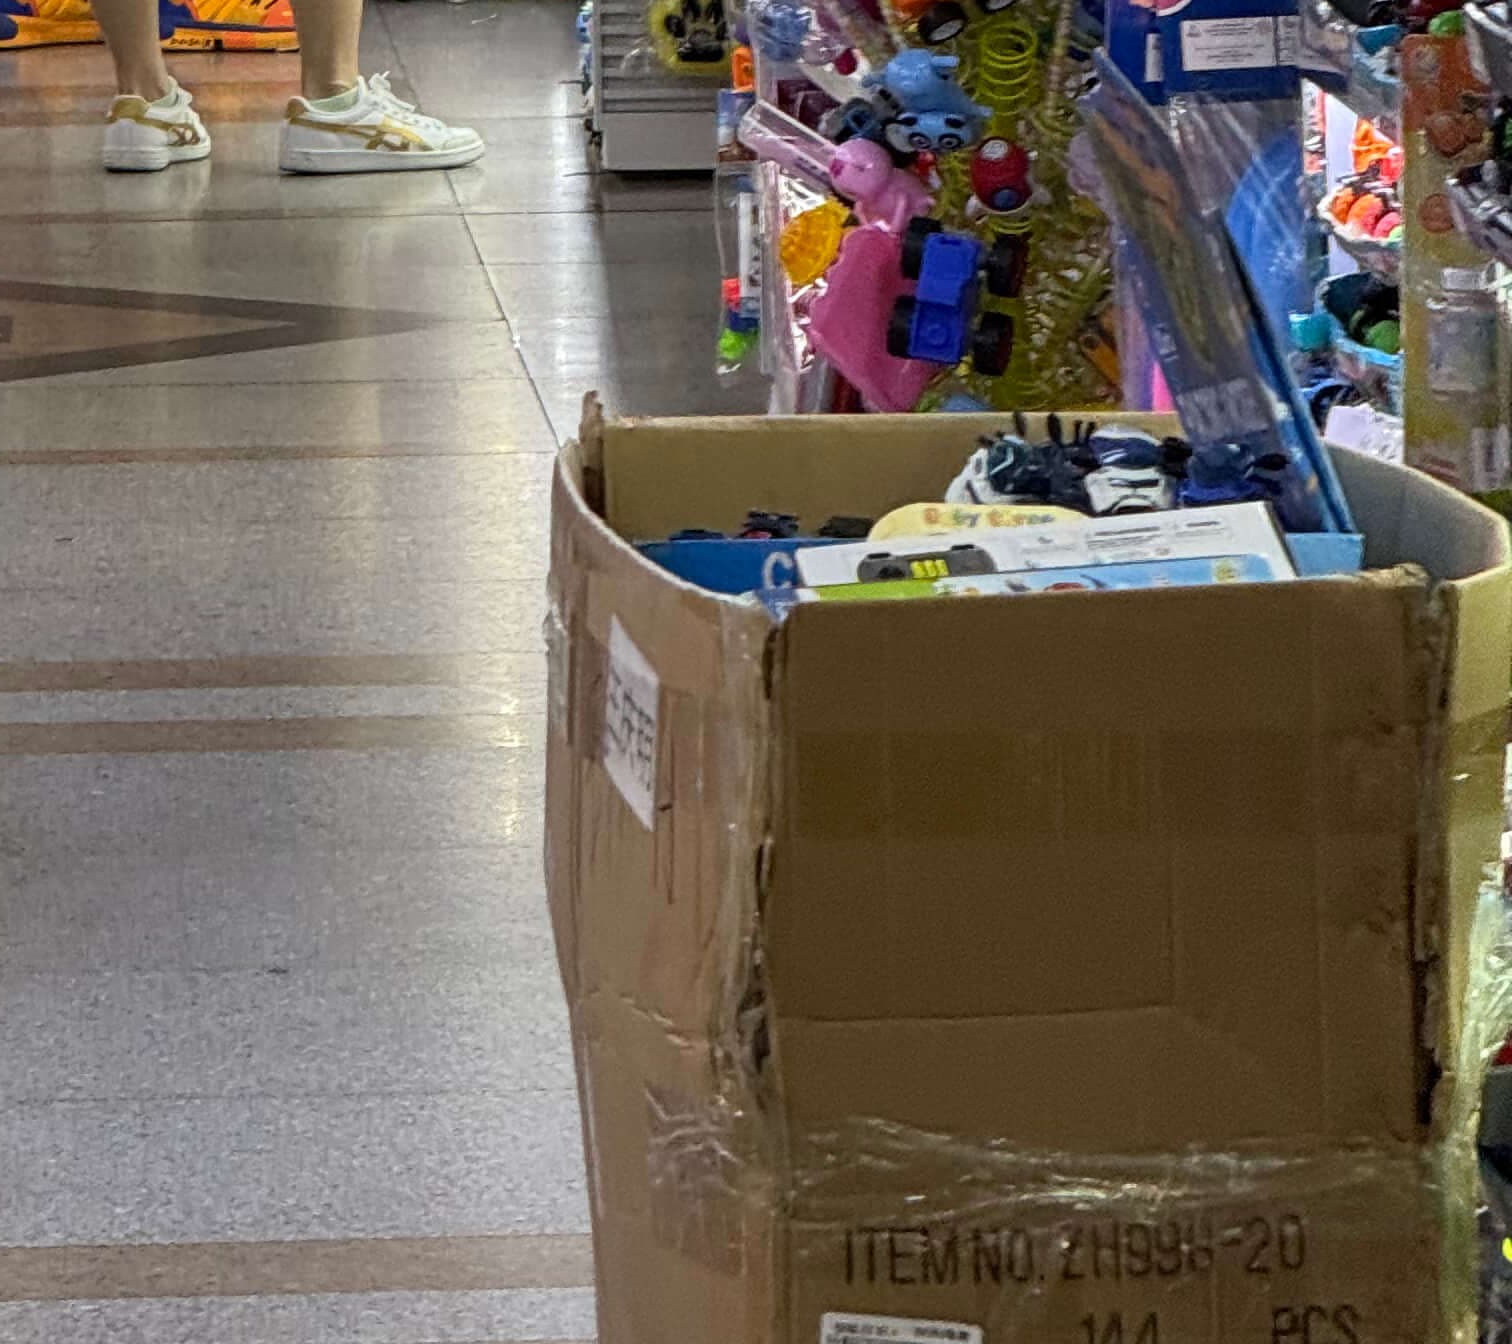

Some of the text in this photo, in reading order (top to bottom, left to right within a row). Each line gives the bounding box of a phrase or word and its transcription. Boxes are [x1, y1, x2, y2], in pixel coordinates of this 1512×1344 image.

[762, 551, 794, 589] C
[843, 1226, 959, 1285] ITEM
[971, 1227, 1046, 1285] NO.
[1271, 1304, 1364, 1344] PCS
